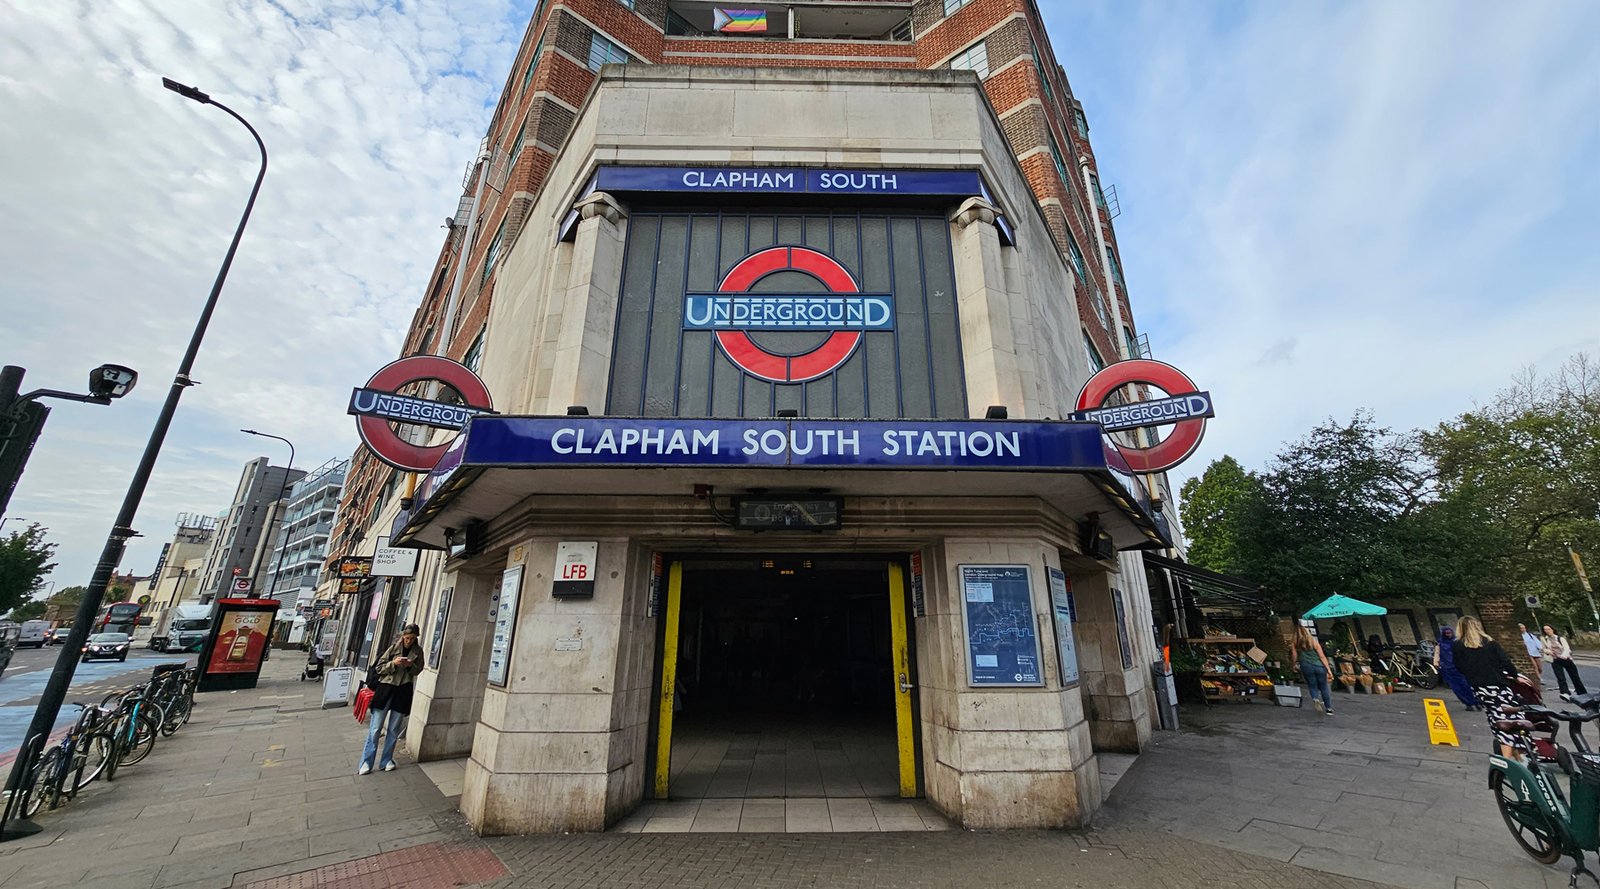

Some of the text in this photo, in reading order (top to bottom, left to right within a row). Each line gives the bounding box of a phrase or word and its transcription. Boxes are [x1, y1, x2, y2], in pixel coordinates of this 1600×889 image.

[682, 171, 898, 190] CLAPHAM SOUTH
[686, 297, 891, 326] UNDERGROUND
[353, 390, 472, 424] UNDERGROUN
[550, 428, 1021, 458] CLAPHAM SOUTH STATION
[563, 564, 588, 579] LFB
[1535, 774, 1557, 812] forest
